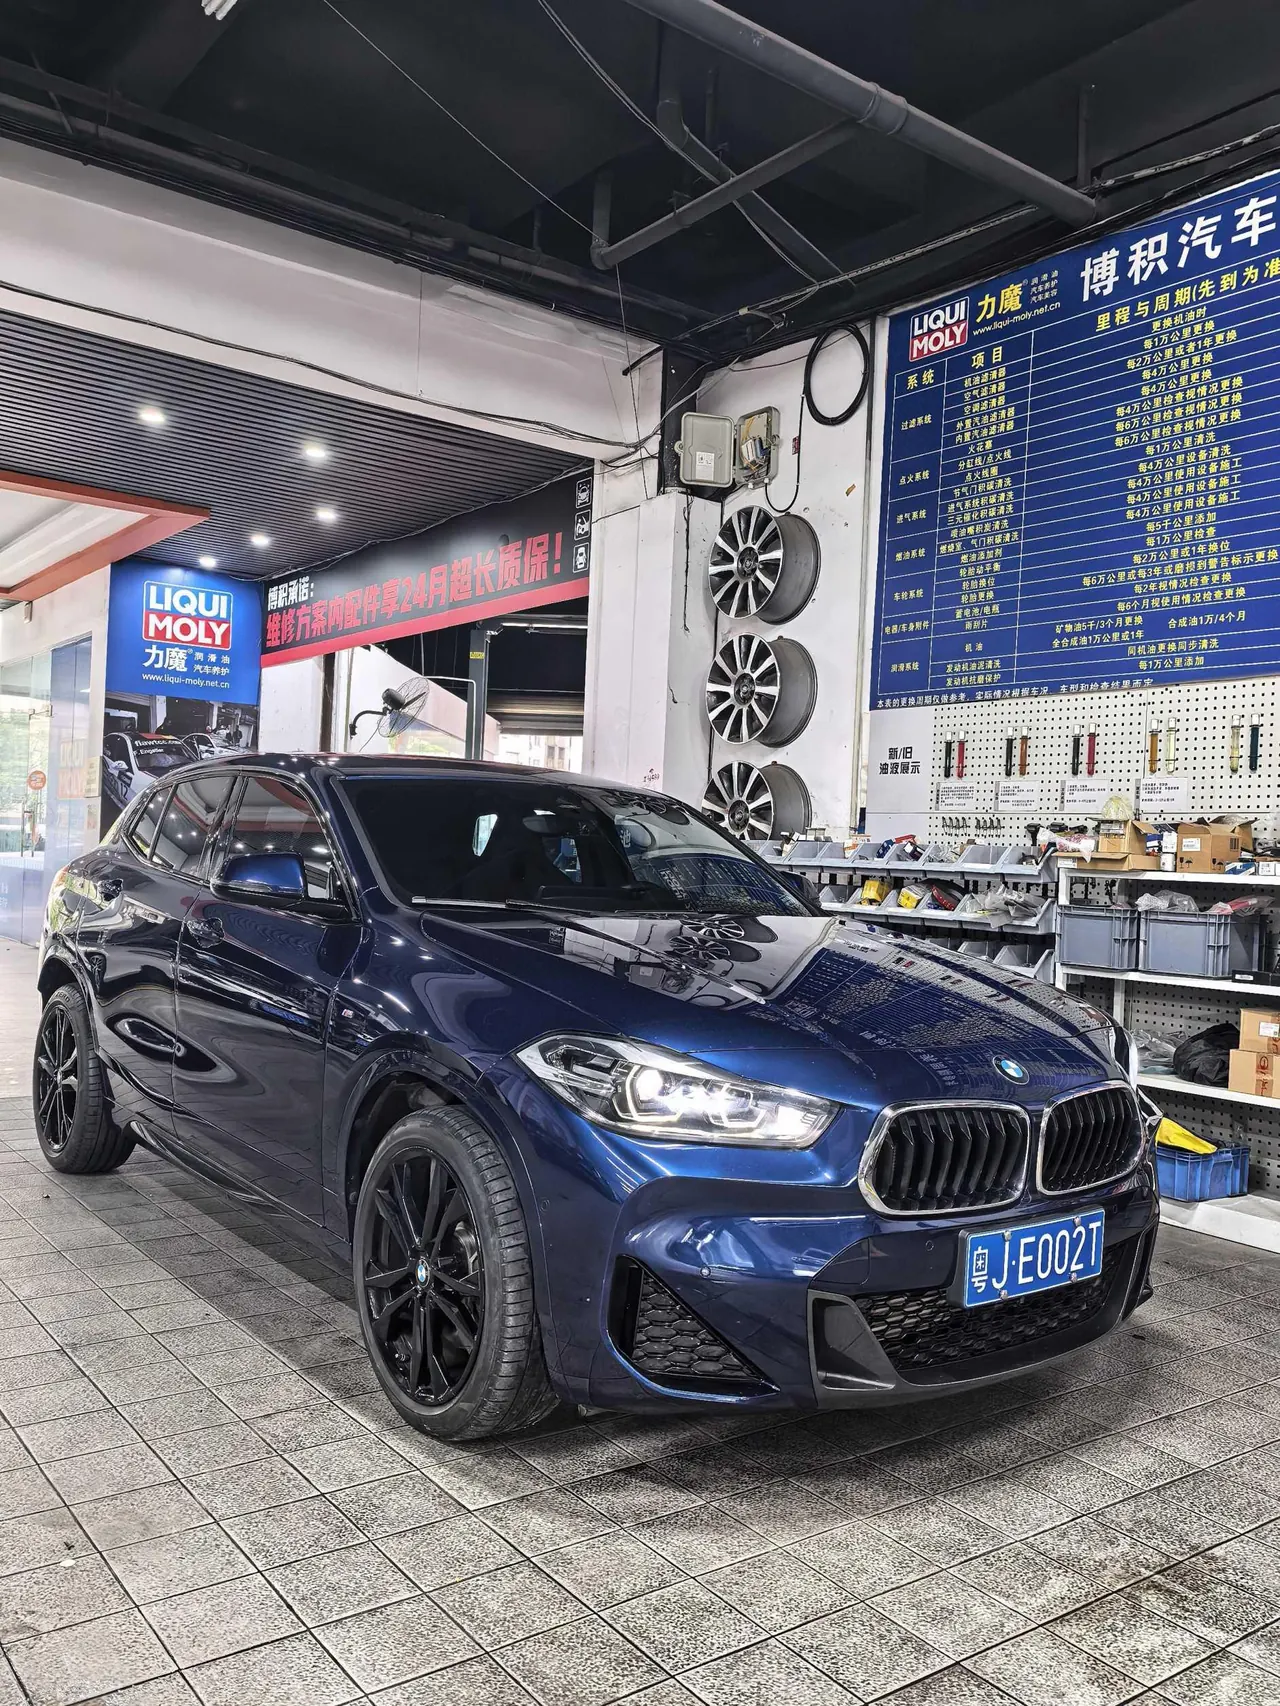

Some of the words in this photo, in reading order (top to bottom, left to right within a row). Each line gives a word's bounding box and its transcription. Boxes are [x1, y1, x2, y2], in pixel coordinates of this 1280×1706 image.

[1081, 196, 1277, 301] 博积汽车
[976, 283, 1023, 323] 力魔
[914, 300, 967, 337] LIQUI
[973, 302, 1061, 336] www.liqui-moly.net.cn
[1152, 306, 1207, 332] 更换机油时
[912, 323, 966, 358] MOLY
[1143, 320, 1215, 349] 每1万公里更换
[971, 346, 1002, 369] 项目
[1126, 329, 1237, 370] 每2万公里或者1年更换
[964, 367, 1006, 388] 机油滤清器
[1142, 352, 1213, 380] 每4万公里更换
[907, 369, 935, 390] 系统
[963, 381, 1006, 402] 空气滤清器
[1141, 369, 1213, 397] 每4万公里更换
[963, 395, 1006, 415] 空调滤清器
[1116, 376, 1244, 417] 每4万公里检查视情况更换
[900, 414, 932, 431] 过滤系统
[956, 406, 1015, 431] 外置汽油滤清器
[1115, 392, 1243, 432] 每6万公里检查视情况更换
[955, 420, 1015, 444] 内置汽油滤清器
[1114, 409, 1242, 448] 每6万公里检查视情况更换
[968, 440, 993, 454] 火花塞
[1145, 431, 1216, 456] 每1万公里清洗
[1138, 444, 1231, 473] 每4万公里设备清洗
[899, 470, 930, 486] 点火系统
[1127, 457, 1242, 489] 每4万公里使用设备施工
[1126, 474, 1241, 505] 每4万公里使用设备施工
[1125, 491, 1241, 520] 每4万公里使用设备施工
[1146, 511, 1217, 533] 每5千公里添加
[1145, 526, 1216, 547] 每1万公里检查
[1133, 540, 1230, 564] 每2万公里或1年换位
[1134, 572, 1232, 594] 每2年视情况检查更换
[149, 585, 228, 618] LIQUI
[148, 613, 230, 646] MOLY
[1168, 610, 1247, 630] 合成油1万/4个月
[142, 645, 188, 672] 力魔
[193, 664, 230, 676] 汽车养护
[194, 652, 230, 664] 润滑油
[142, 673, 230, 689] www.liqui-moly.net.cn
[888, 746, 913, 760] 新/旧
[879, 761, 921, 775] 油液展示
